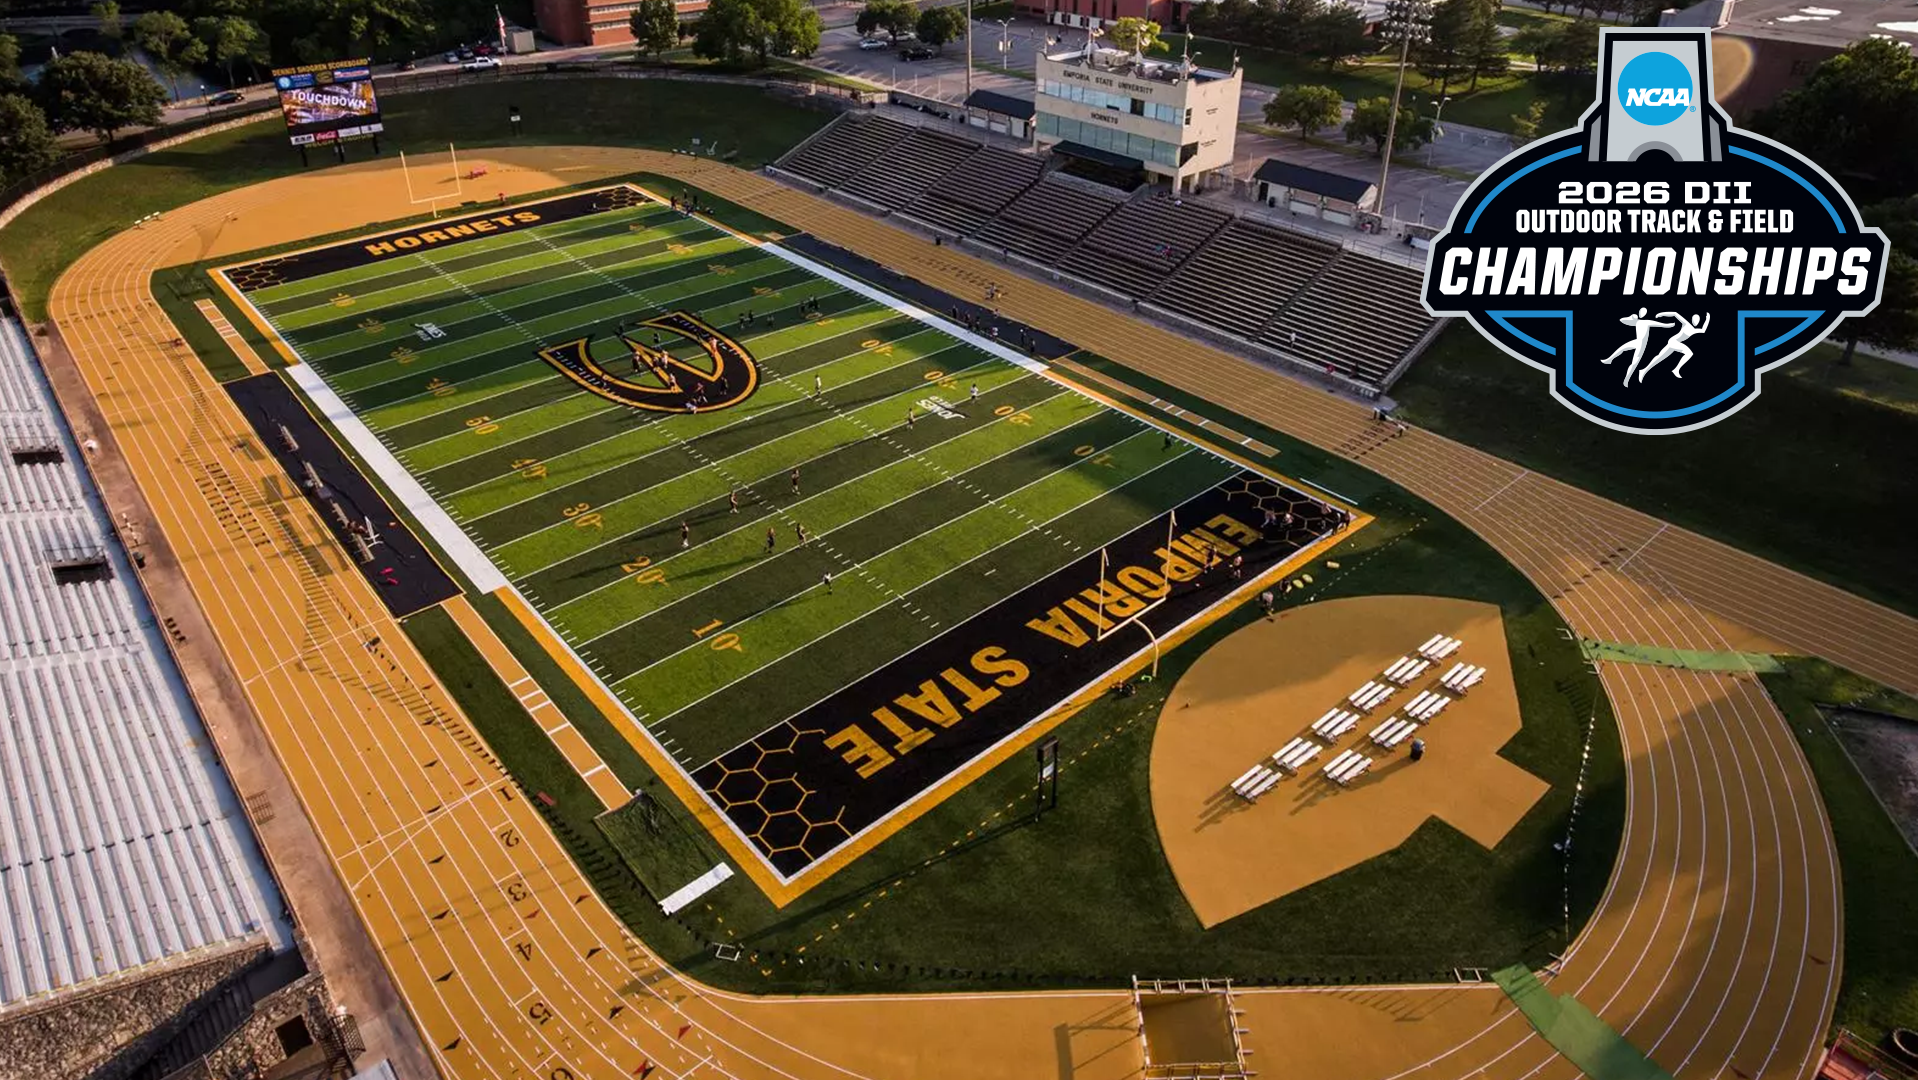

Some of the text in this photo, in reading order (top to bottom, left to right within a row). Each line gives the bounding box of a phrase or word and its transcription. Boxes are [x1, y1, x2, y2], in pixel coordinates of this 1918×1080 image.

[272, 67, 296, 76] DENNIS
[328, 58, 368, 69] SCOREBOARD
[1063, 70, 1154, 94] EMPORIA STATE UNIVERSITY
[291, 90, 367, 108] TOUCHDOWN
[1090, 112, 1119, 125] HORNETS
[365, 211, 541, 256] HORNETS
[466, 416, 499, 435] 50
[511, 458, 546, 478] 40
[563, 503, 600, 527] 30
[621, 556, 665, 584] 20
[1025, 513, 1264, 648] EMPORIA
[692, 619, 739, 650] 10
[822, 645, 1030, 780] STATE
[496, 786, 514, 801] 1
[500, 829, 520, 848] 2
[507, 882, 527, 902] 3
[515, 941, 533, 961] 4
[529, 1002, 552, 1025] 5
